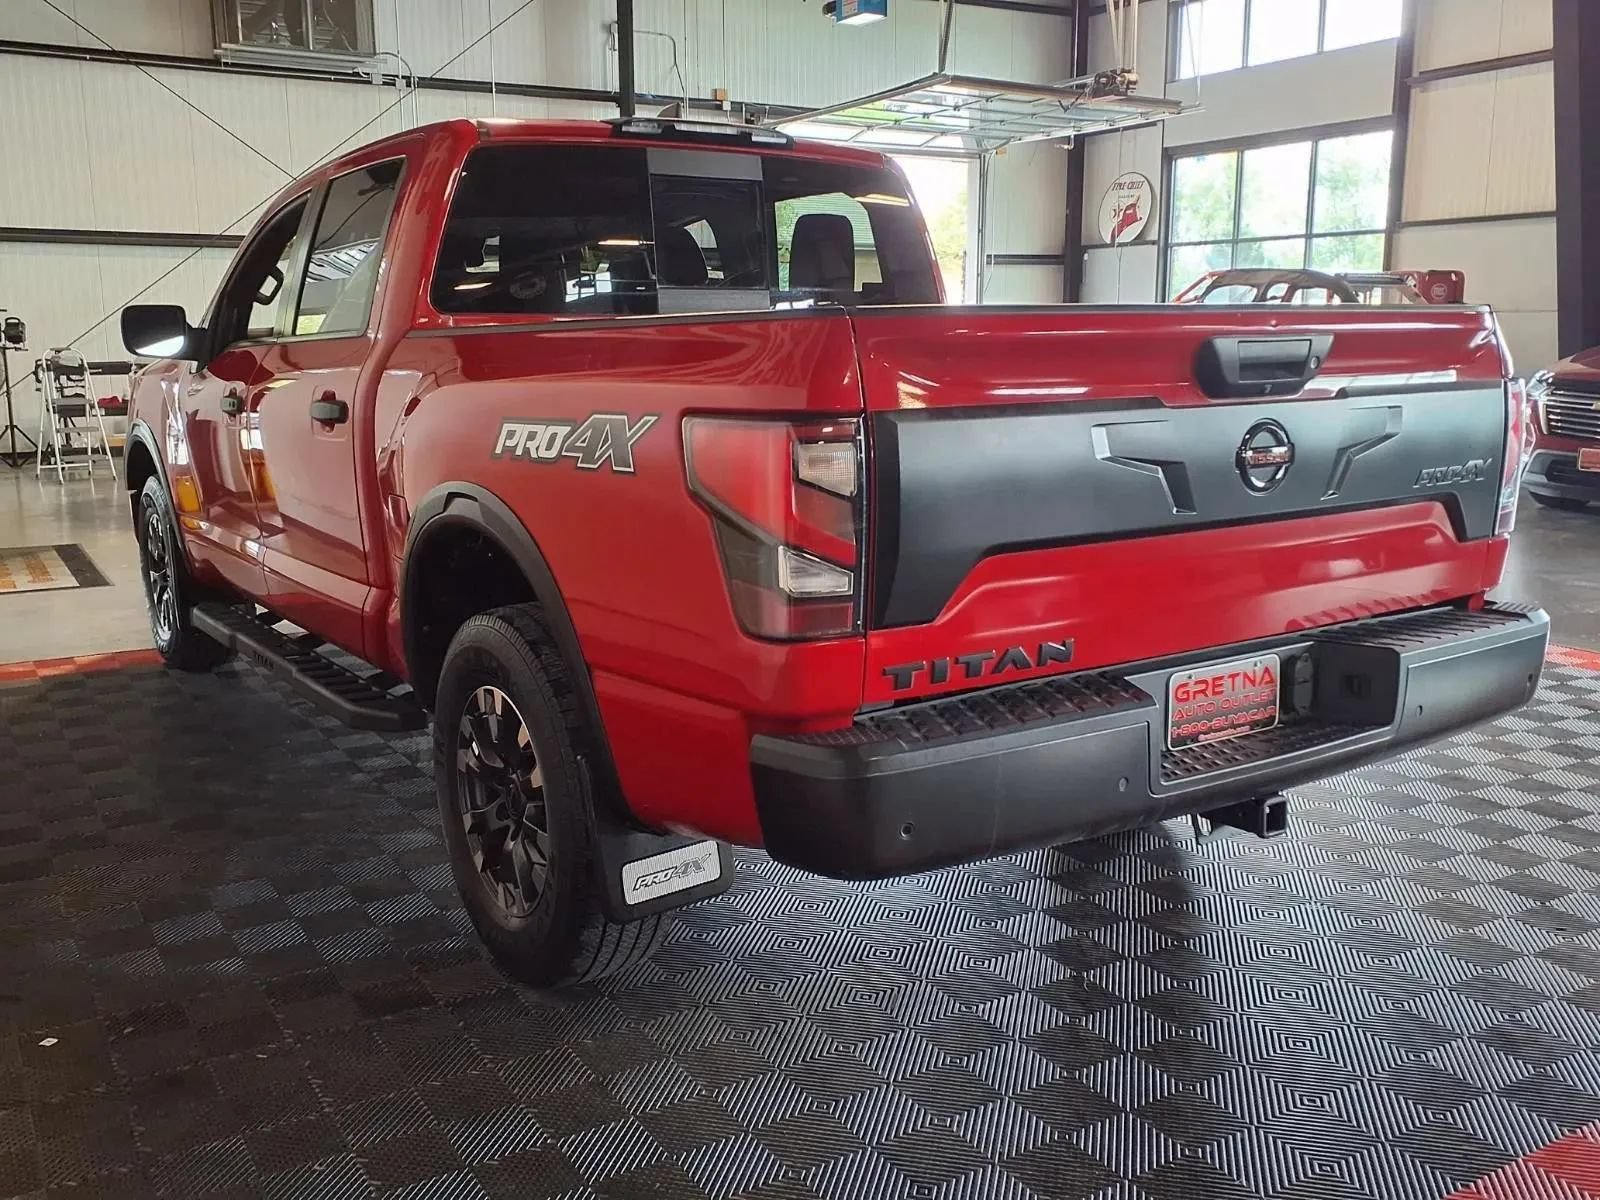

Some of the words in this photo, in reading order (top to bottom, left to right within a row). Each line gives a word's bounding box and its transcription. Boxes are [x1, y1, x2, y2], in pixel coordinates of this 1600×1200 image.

[882, 638, 1075, 690] TITAN
[1174, 666, 1275, 703] GRETNA
[1173, 701, 1216, 721] AUTO
[1220, 688, 1276, 710] OUTLET
